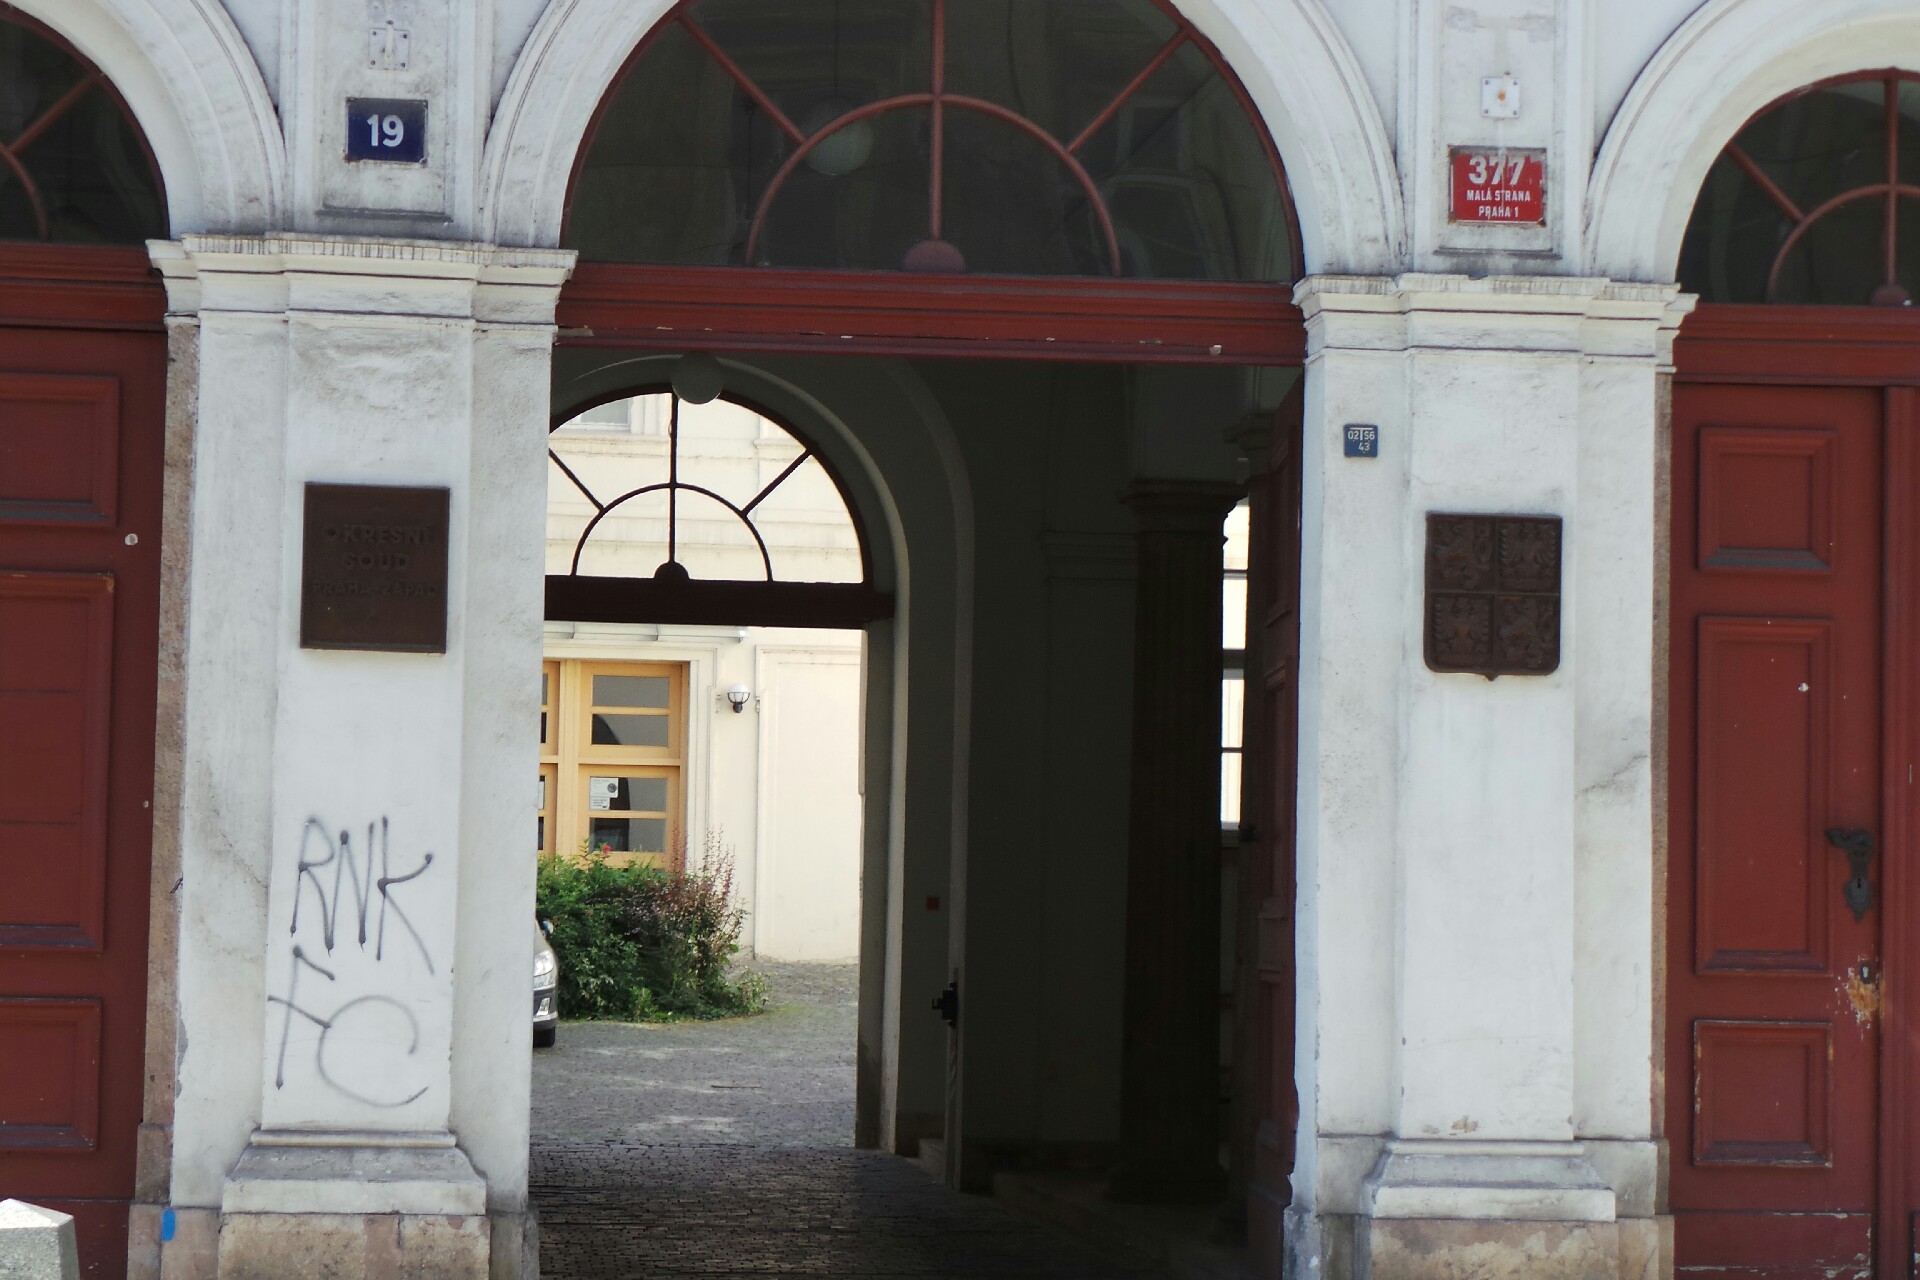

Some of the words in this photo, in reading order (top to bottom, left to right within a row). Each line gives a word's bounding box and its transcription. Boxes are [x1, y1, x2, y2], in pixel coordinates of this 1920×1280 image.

[367, 114, 404, 147] 19
[1468, 155, 1525, 185] 377
[1466, 187, 1492, 201] MALÁ
[1494, 189, 1531, 202] STRANA
[1478, 205, 1511, 218] PRAHA
[1514, 206, 1519, 218] 1
[343, 551, 411, 572] SOUD
